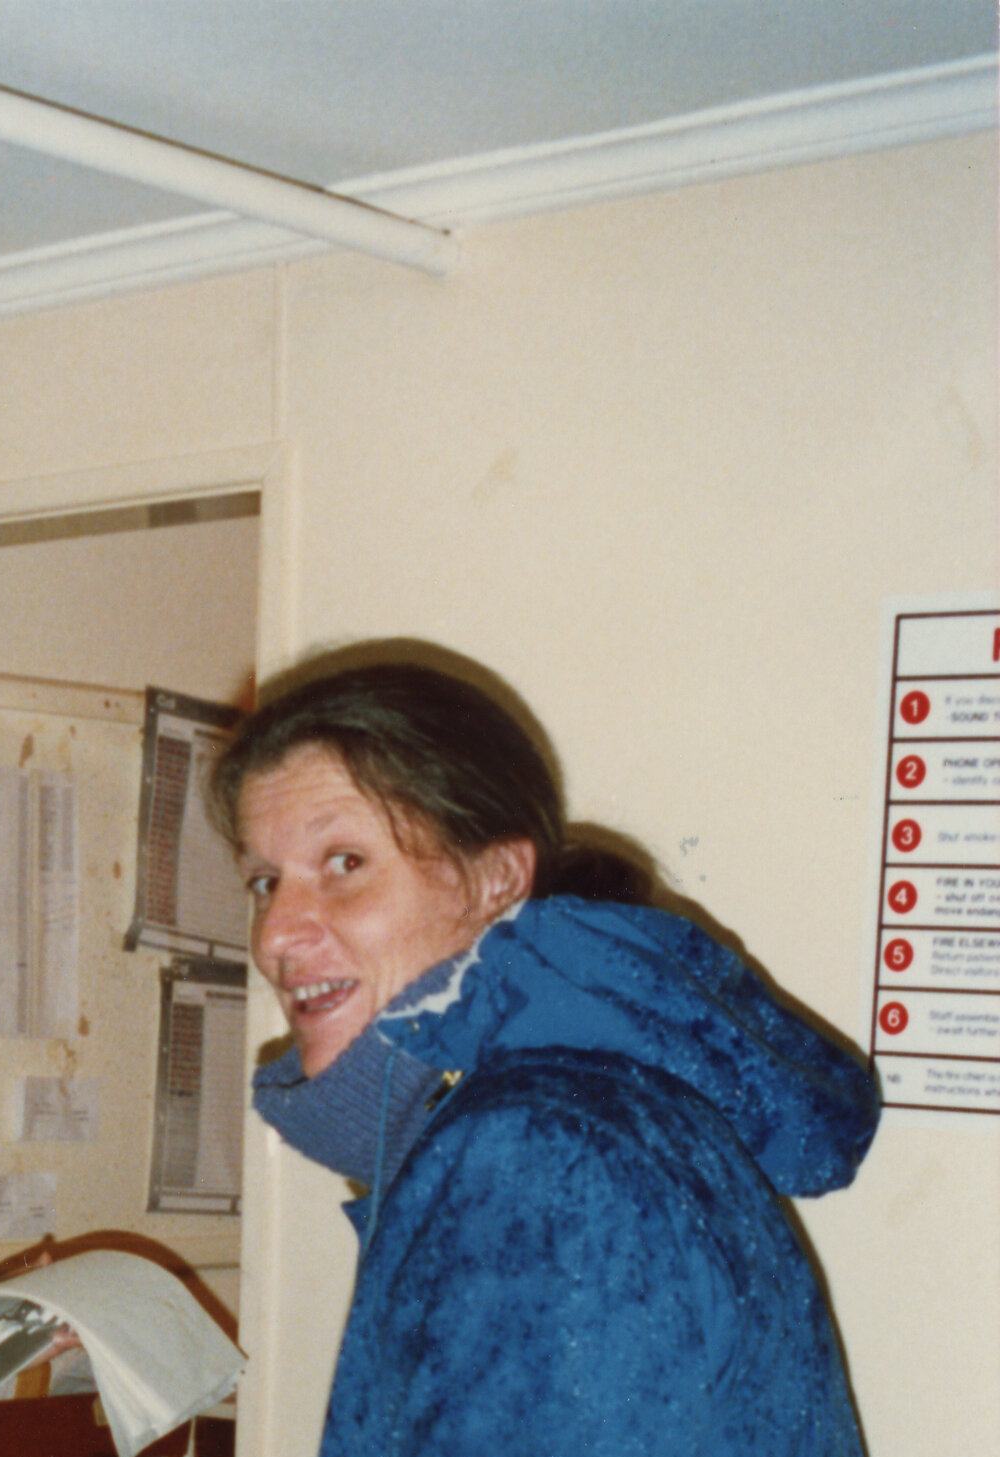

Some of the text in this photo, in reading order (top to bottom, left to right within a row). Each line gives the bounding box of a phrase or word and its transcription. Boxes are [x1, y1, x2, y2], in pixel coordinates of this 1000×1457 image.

[909, 699, 918, 717] 1
[950, 711, 988, 722] SOUND
[905, 762, 917, 780] 2
[942, 758, 978, 768] PHONE
[901, 827, 913, 845] 3
[936, 877, 959, 887] FIRE
[963, 878, 974, 887] IN
[895, 888, 907, 906] 4
[933, 937, 955, 947] FIRE
[892, 946, 904, 964] 5
[887, 1009, 900, 1027] 6
